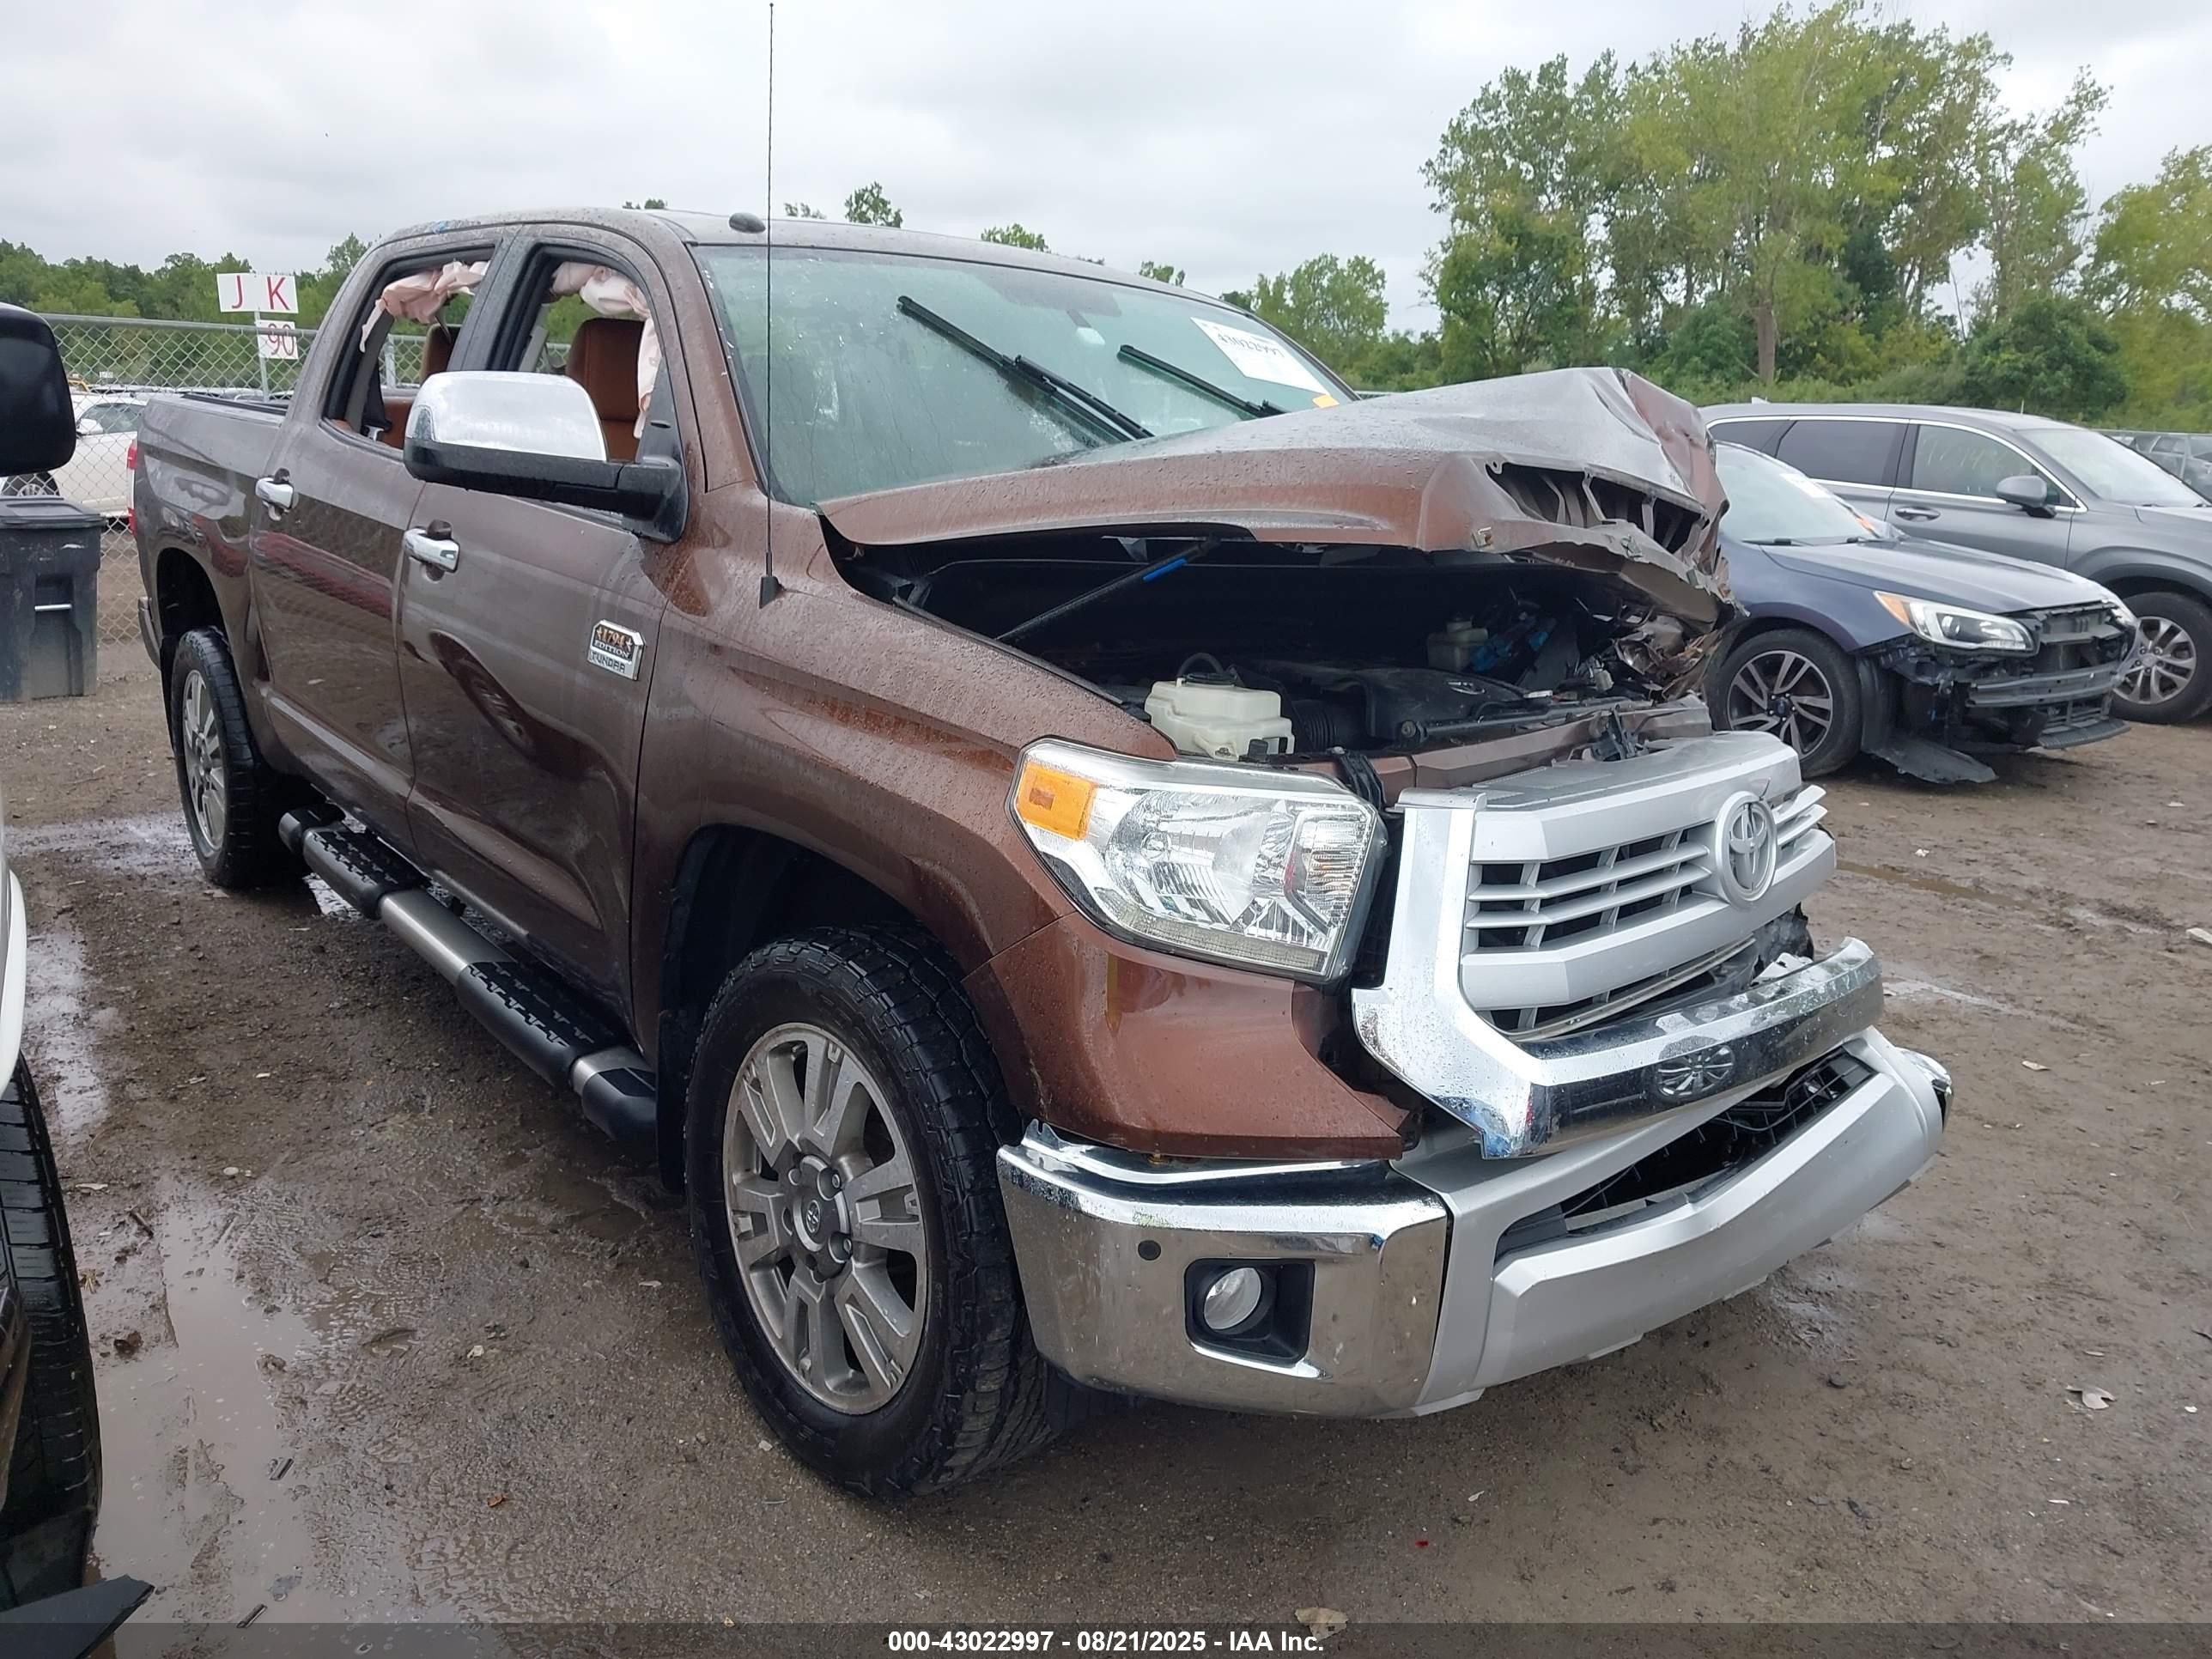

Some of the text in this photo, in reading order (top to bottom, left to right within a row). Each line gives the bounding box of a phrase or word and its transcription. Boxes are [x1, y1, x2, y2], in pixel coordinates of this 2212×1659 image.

[232, 275, 290, 311] J K
[268, 323, 295, 356] 90
[594, 639, 630, 659] EDITION
[603, 628, 627, 647] 1794
[591, 651, 626, 674] TUNDRA
